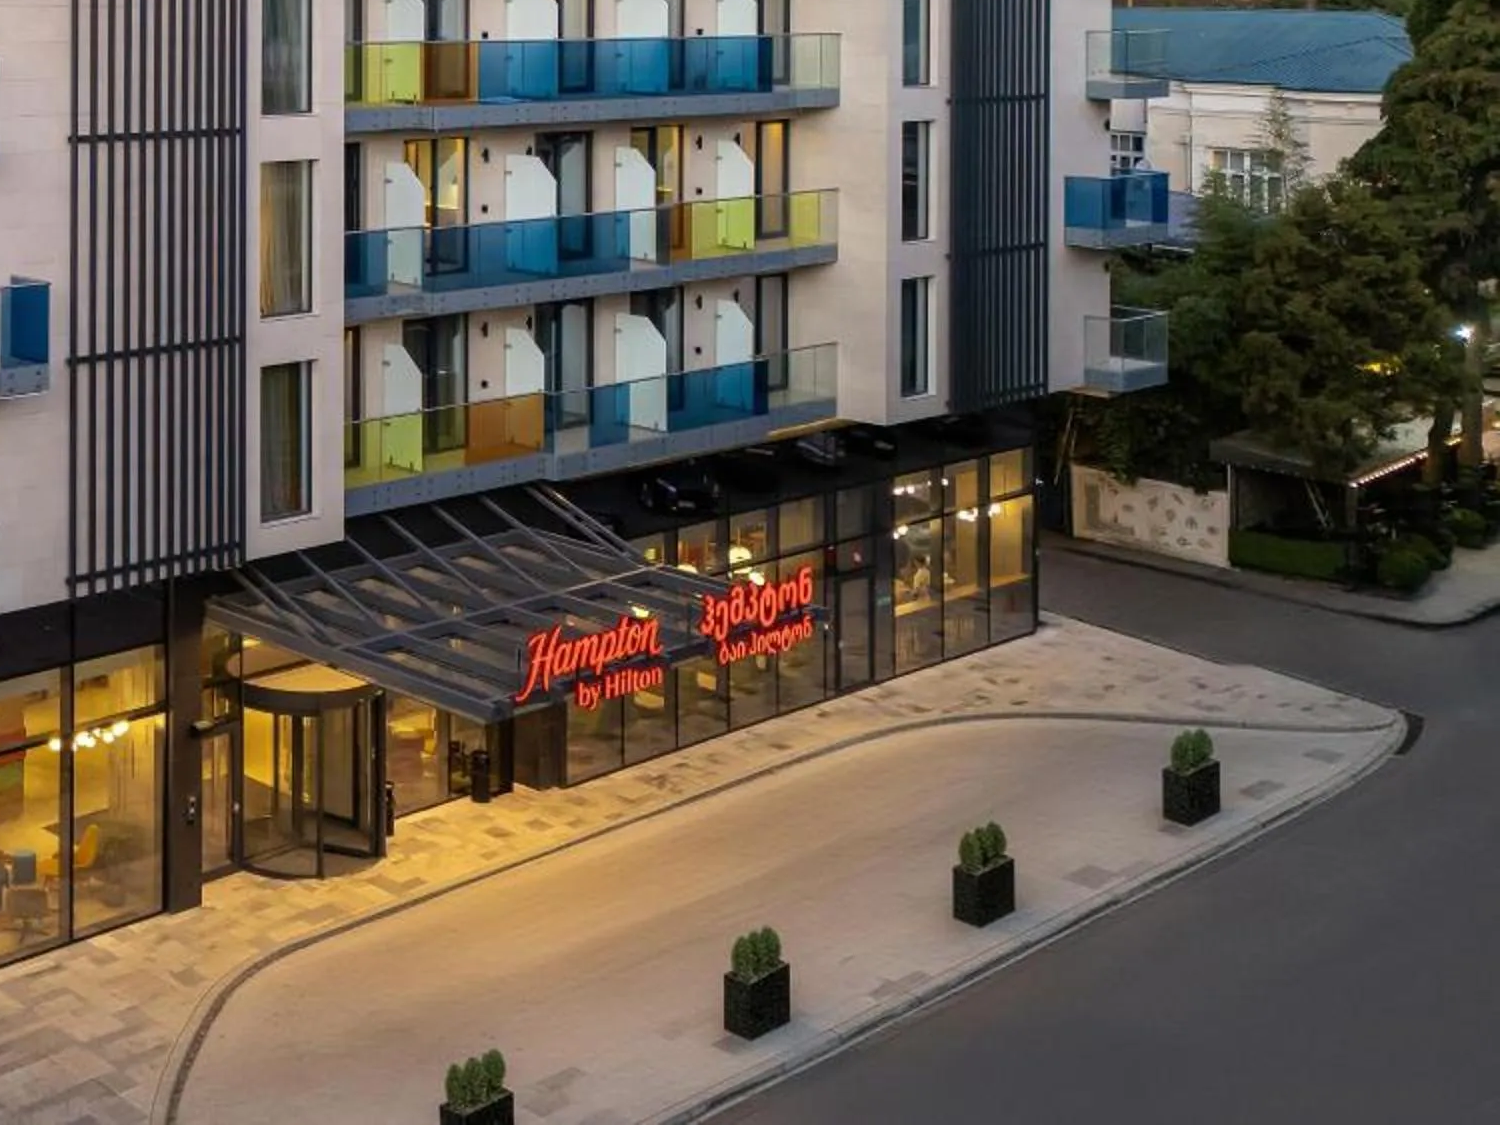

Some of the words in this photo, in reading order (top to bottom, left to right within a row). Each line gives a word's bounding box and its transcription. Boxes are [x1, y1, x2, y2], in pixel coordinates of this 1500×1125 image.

[701, 565, 813, 641] ჰემპტონ
[515, 613, 663, 702] Hampton
[574, 680, 603, 710] by
[604, 666, 663, 699] Hilton
